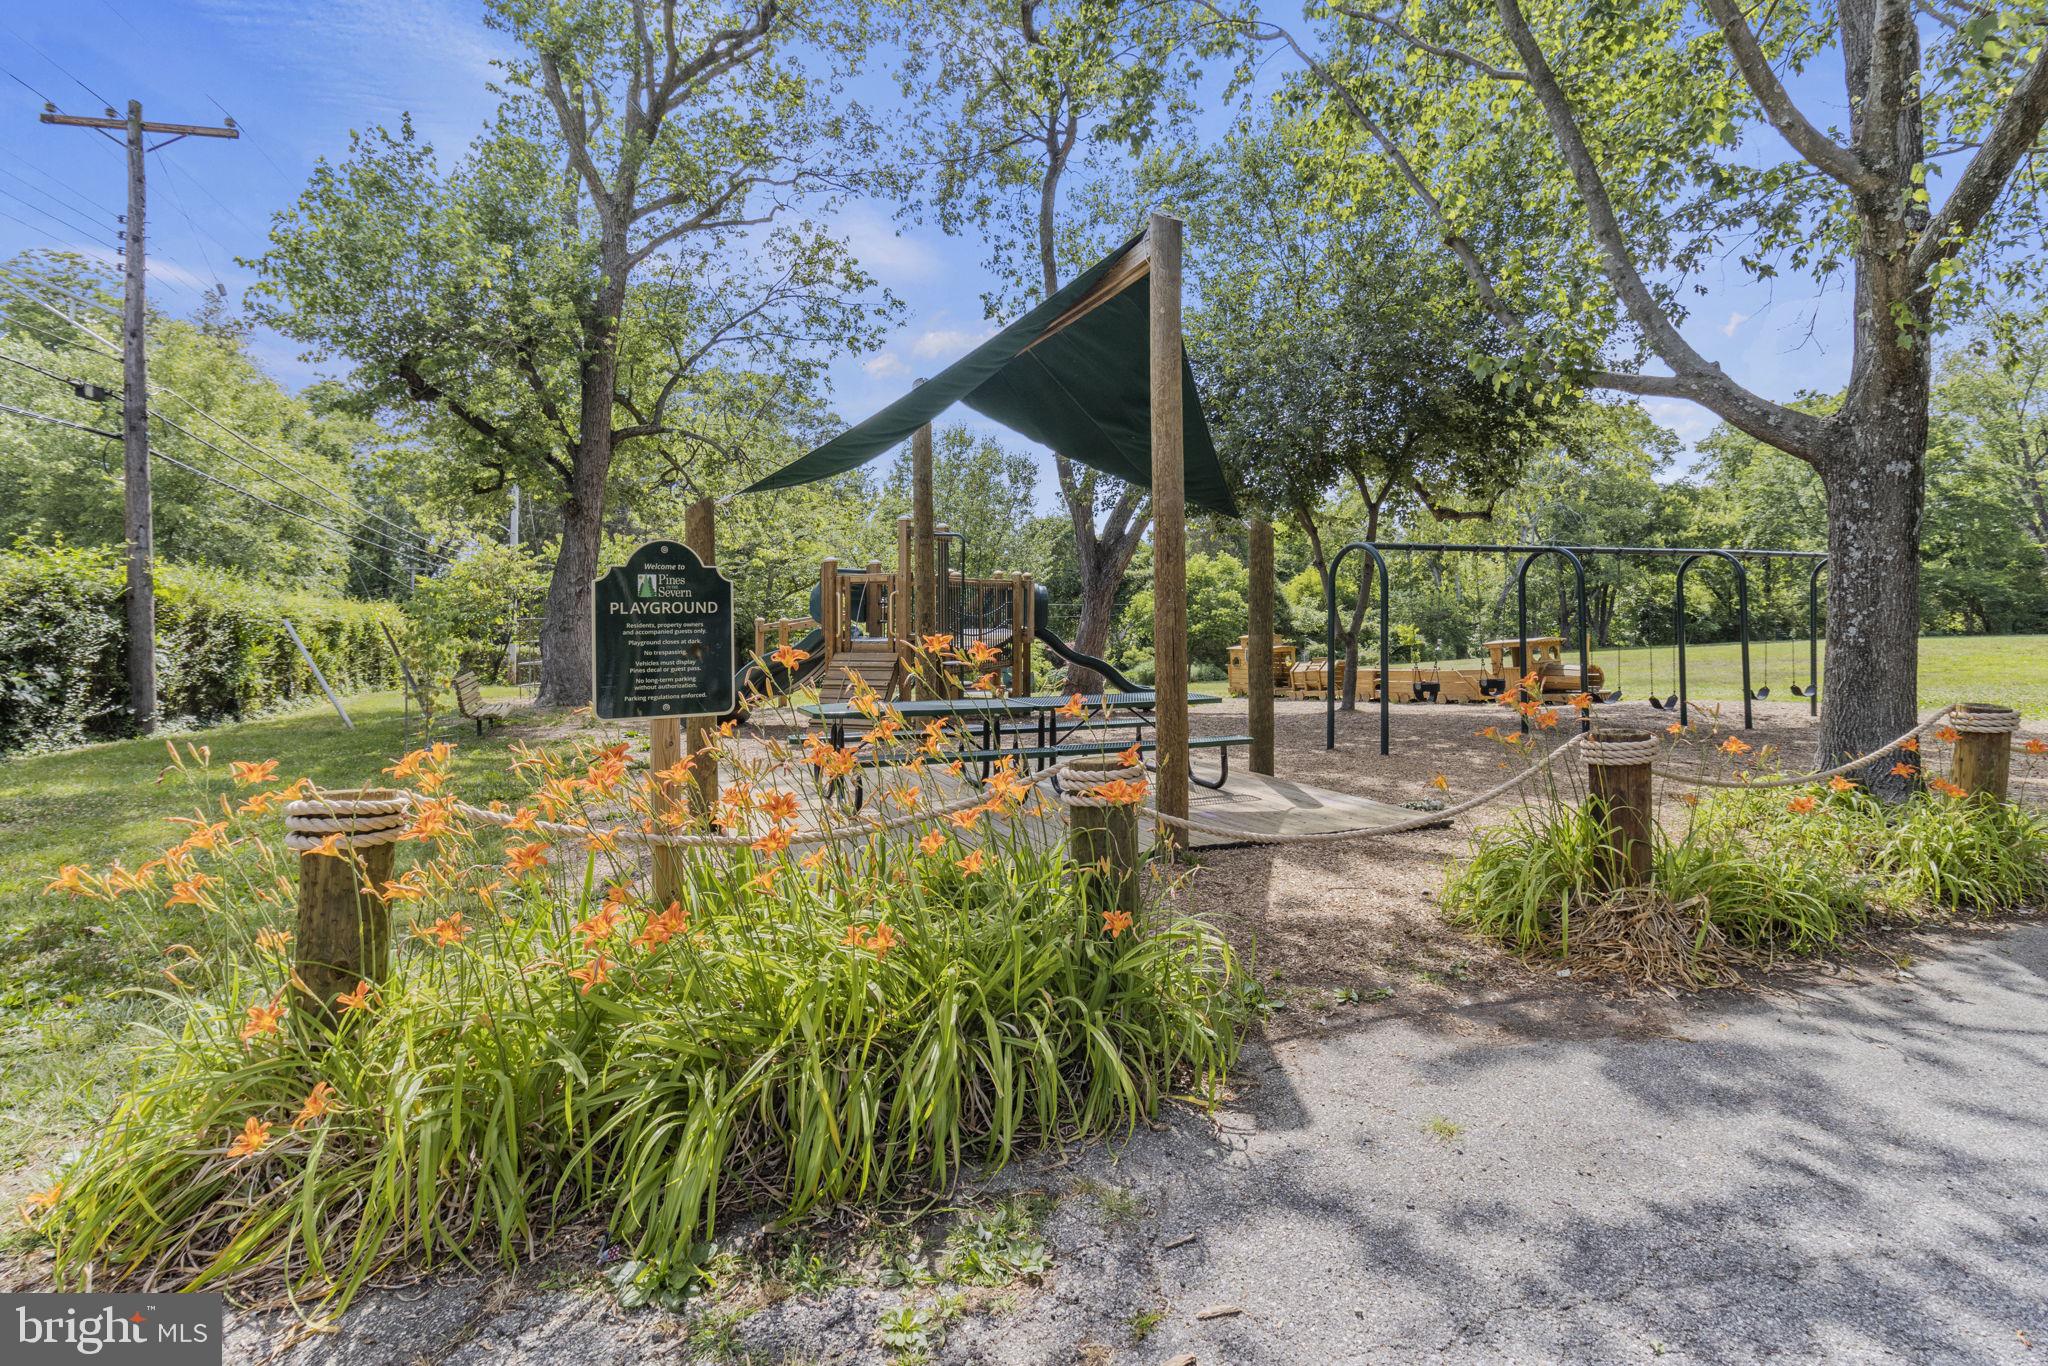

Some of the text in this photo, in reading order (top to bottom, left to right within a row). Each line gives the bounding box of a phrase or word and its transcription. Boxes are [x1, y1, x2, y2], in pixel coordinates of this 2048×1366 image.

[659, 574, 685, 585] Pines
[659, 587, 692, 597] Severn
[610, 602, 718, 614] PLAYGROUND
